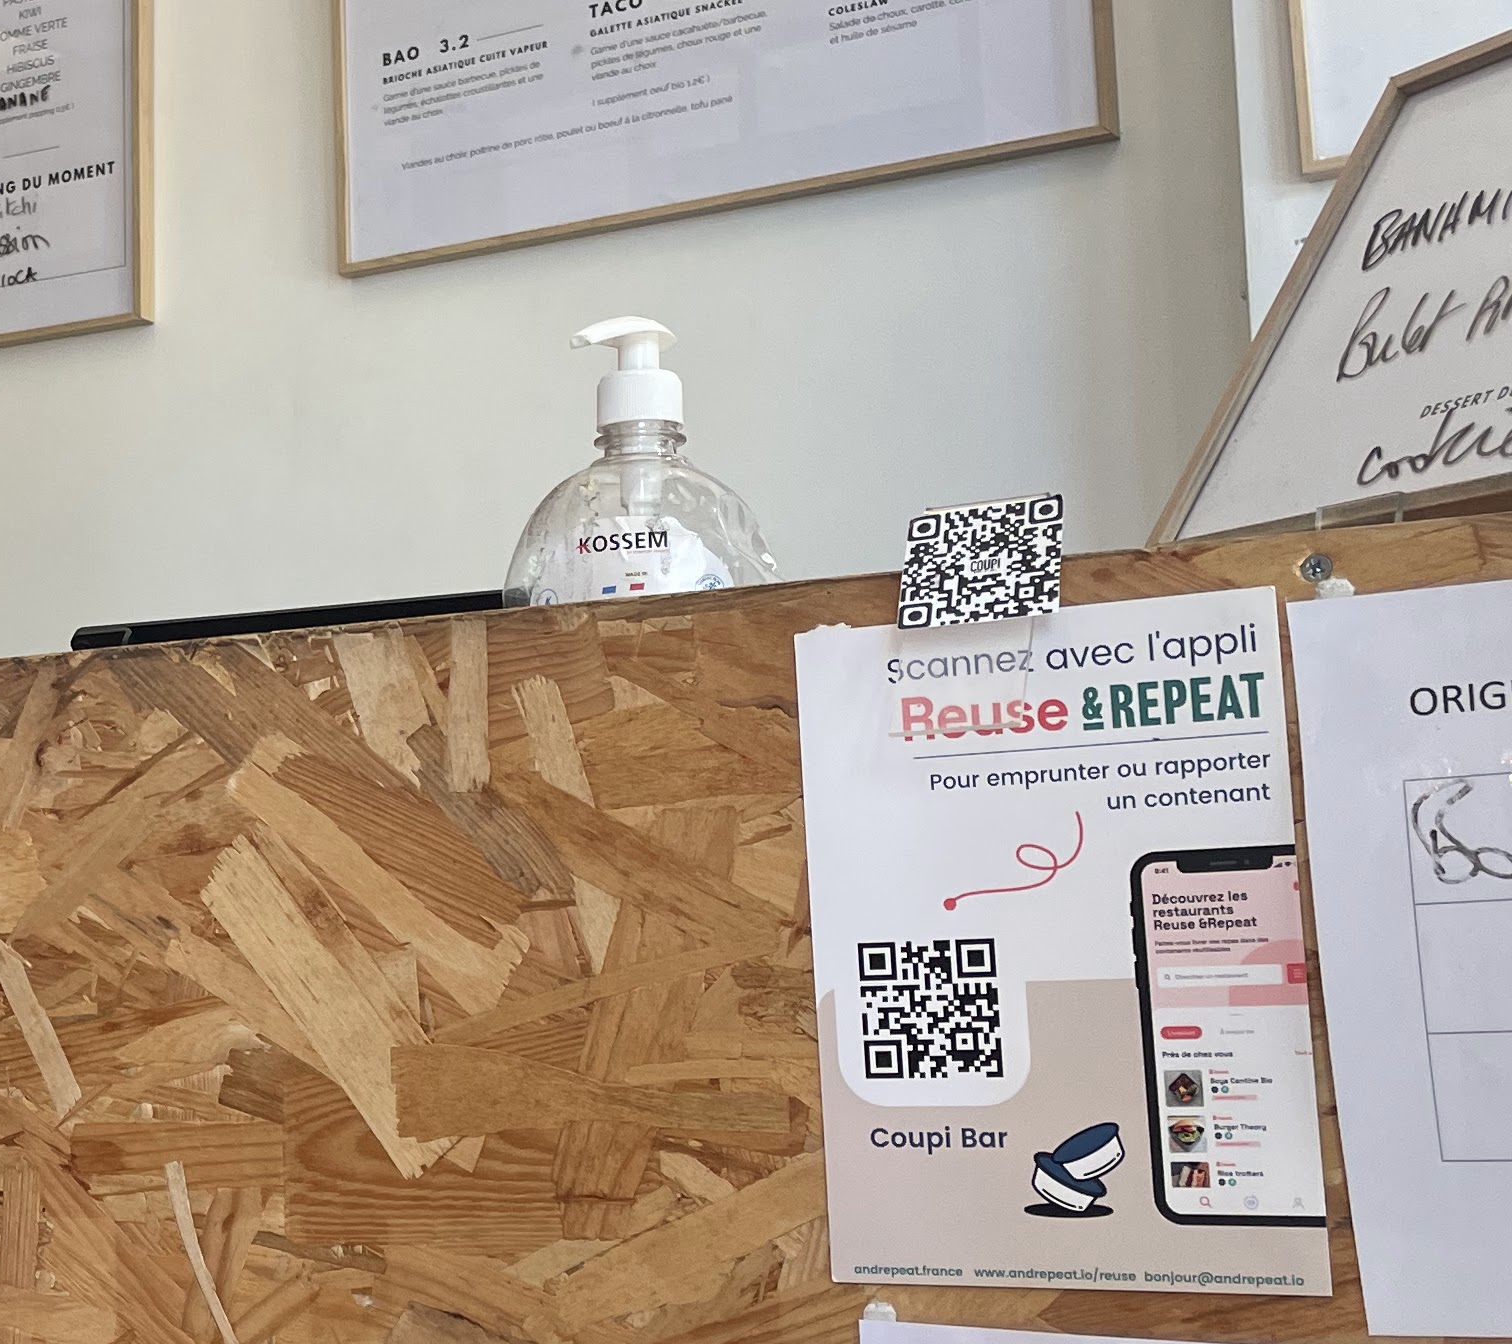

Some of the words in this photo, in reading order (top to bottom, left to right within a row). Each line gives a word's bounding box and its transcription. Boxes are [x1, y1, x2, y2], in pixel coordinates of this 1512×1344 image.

[590, 21, 632, 38] GALETTE
[636, 7, 691, 27] ASIATIQUE
[382, 46, 420, 67] BAO
[440, 34, 470, 53] 3.2
[383, 70, 422, 85] BRIOCHE
[426, 57, 476, 76] ASIATIQUE
[509, 40, 548, 57] VAPEUR
[22, 176, 41, 190] DU
[48, 161, 115, 186] MOMENT
[1420, 389, 1494, 418] DESSERT
[576, 531, 668, 554] KOSSEM
[970, 557, 1001, 573] COUPI
[887, 648, 1034, 684] Scannez
[1047, 642, 1134, 671] avec
[1148, 624, 1257, 666] l'appli
[901, 697, 1068, 741] Reuse
[930, 774, 979, 790] Pour
[987, 762, 1109, 790] emprunter
[1117, 762, 1146, 777] ou
[1156, 752, 1270, 778] rapporter
[1107, 793, 1136, 810] un
[1145, 783, 1270, 807] contenant
[1152, 892, 1224, 905] Découvrez
[1228, 891, 1248, 900] les
[1153, 905, 1233, 917] restaurants
[1154, 919, 1194, 930] Reuse
[1199, 917, 1257, 930] &Repeat
[871, 1127, 952, 1154] Coupi
[962, 1128, 1007, 1148] Bar
[854, 1264, 963, 1278] andrepeat.france
[974, 1267, 1136, 1283] www.andrepeat.io/reuse
[1144, 1271, 1304, 1287] bonjour@andrepeat.io
